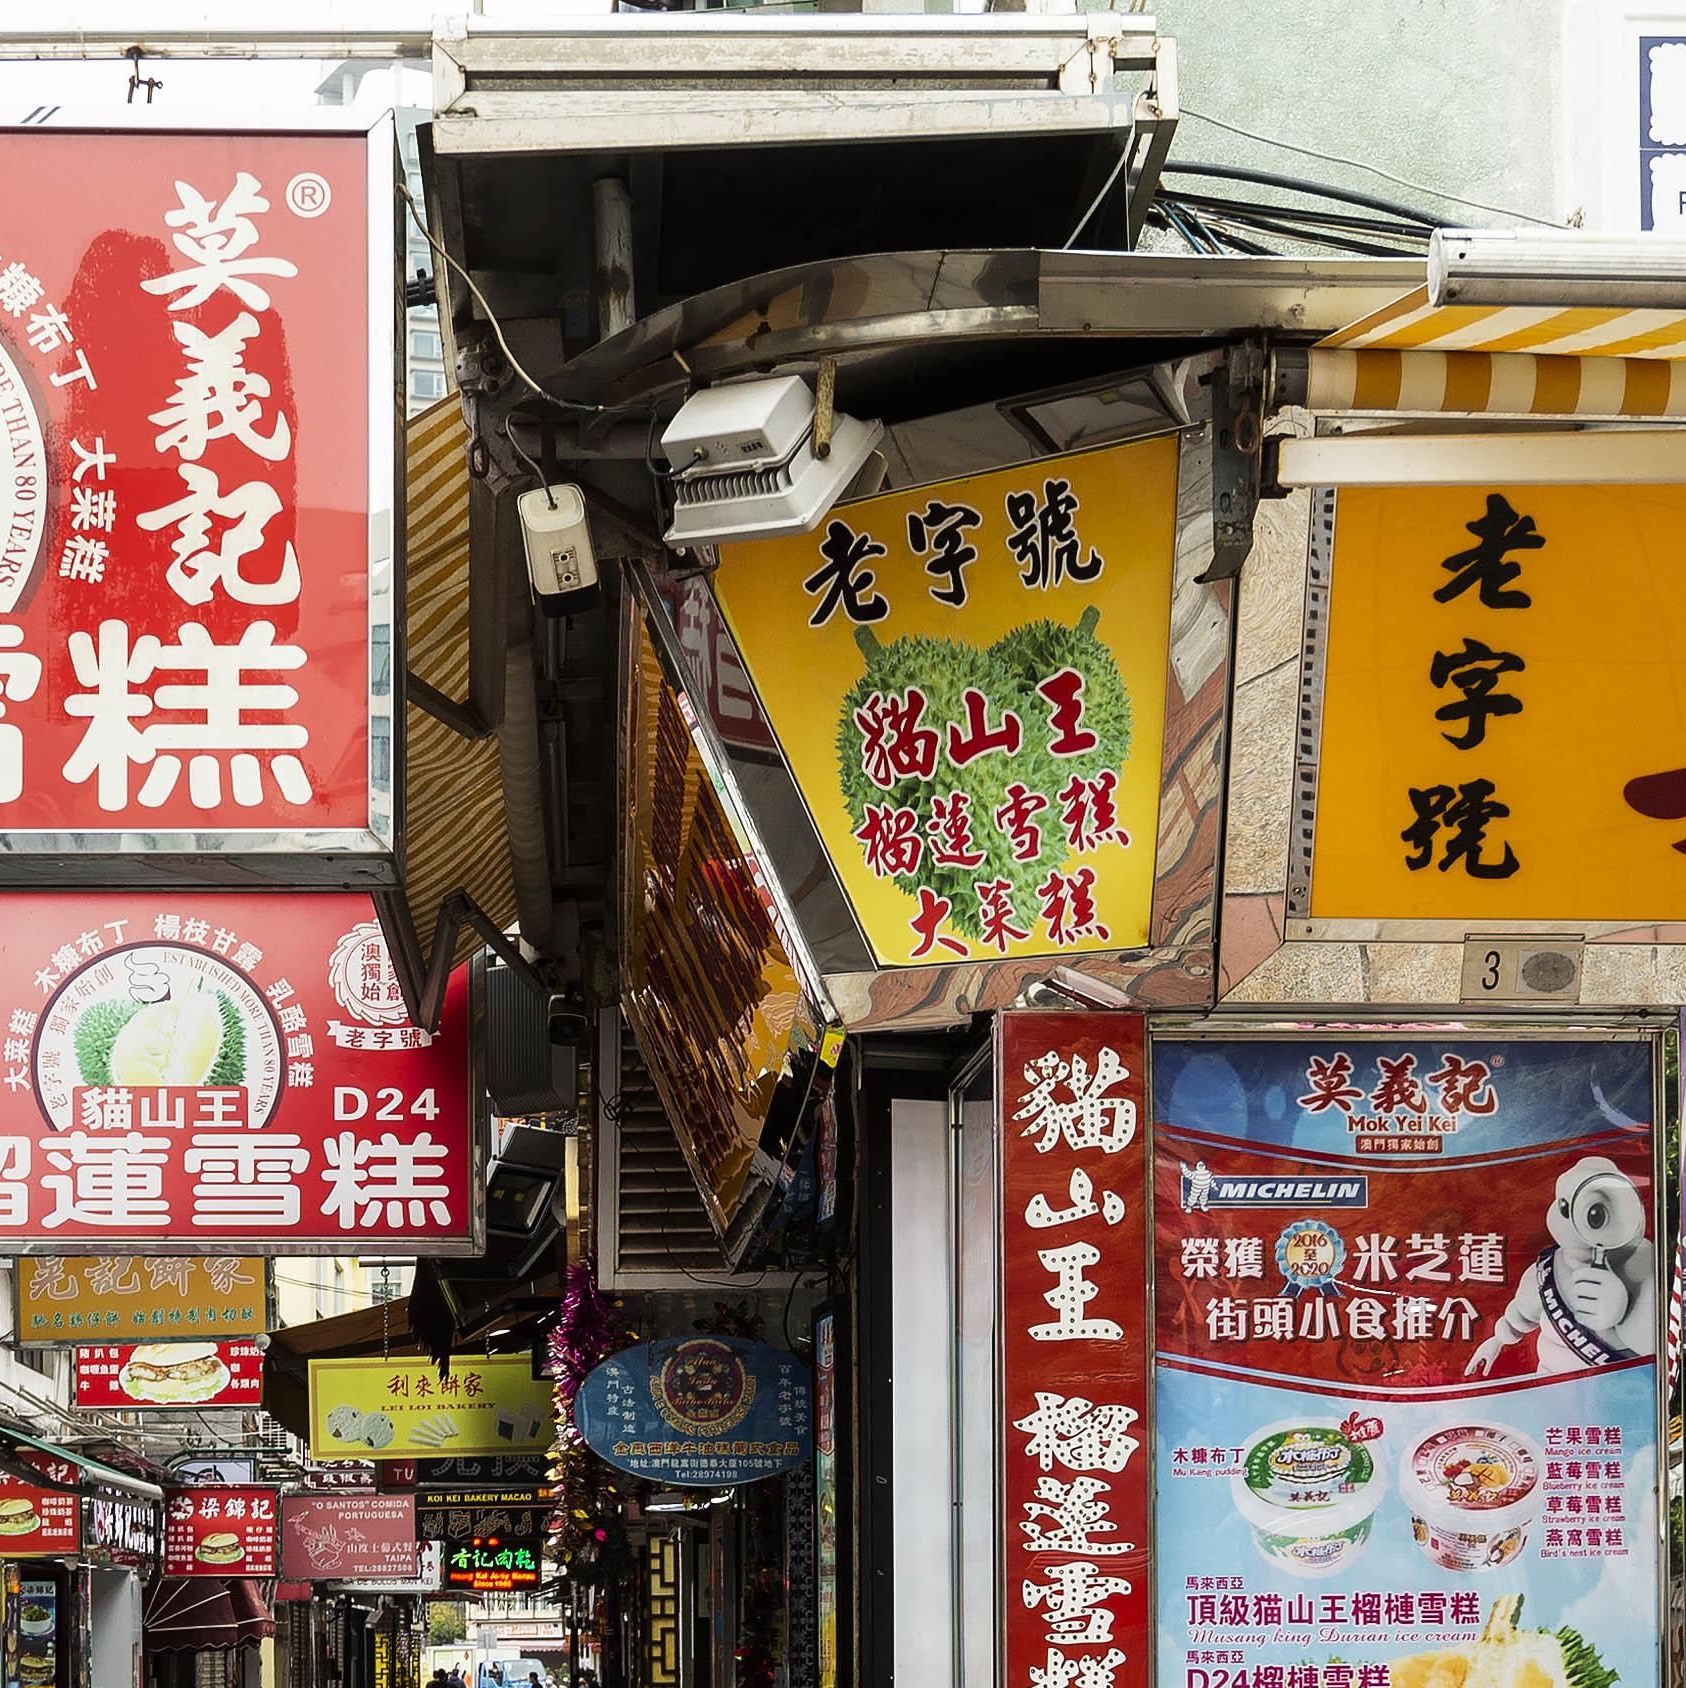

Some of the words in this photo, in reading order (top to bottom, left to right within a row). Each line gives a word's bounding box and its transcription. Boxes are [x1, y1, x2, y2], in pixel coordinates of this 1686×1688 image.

[141, 170, 303, 608] 莫義記
[1, 396, 36, 470] THAN
[14, 476, 37, 501] 80
[56, 437, 118, 584] 大菜糕
[804, 480, 1103, 627] 老字號
[1400, 493, 1547, 880] 老字號
[858, 772, 1131, 877] 榴蓮雪糕
[908, 868, 1113, 959] 大菜糕
[32, 918, 130, 995] 木糠布丁
[154, 913, 265, 973] 楊枝甘露
[162, 951, 240, 999] ESTABLISHED
[1481, 948, 1503, 991] 3
[49, 966, 114, 1036] 獨家始創
[239, 991, 267, 1027] MORE
[2, 1007, 39, 1092] 大菜糕
[258, 1024, 277, 1057] THAN
[265, 978, 315, 1089] 乳酪雪糕
[345, 1028, 423, 1049] 老字號
[41, 1048, 69, 1111] 老字號
[253, 1074, 276, 1116] YEARS
[1297, 1052, 1499, 1116] 莫義記
[80, 1089, 244, 1130] 貓山王
[333, 1087, 441, 1122] D24
[1348, 1116, 1389, 1133] Mok
[1396, 1116, 1422, 1133] Yei
[1429, 1116, 1457, 1133] Kei
[1012, 1046, 1137, 1341] 貓山王
[1219, 1182, 1360, 1199] MICHELIN
[1180, 1237, 1264, 1280] 榮獲
[1353, 1233, 1505, 1283] 米芝蓮
[1205, 1298, 1479, 1341] 街頭小食推介
[381, 1403, 404, 1411] LEI
[409, 1403, 432, 1411] LOI
[437, 1403, 495, 1411] BAKERY
[1173, 1447, 1246, 1465] 木糠布丁
[198, 1498, 274, 1521] 梁錦記
[338, 1511, 404, 1520] PORTUGUESA
[371, 1500, 409, 1509] COMIDA
[446, 1494, 461, 1502] KEI
[464, 1494, 499, 1502] BAKERY
[501, 1493, 531, 1501] MACAO
[385, 1554, 412, 1562] TAIPA
[451, 1548, 536, 1570] 香記肉乾
[1186, 1577, 1244, 1591] 馬來西亞
[1186, 1593, 1481, 1627] 頂級猫山王榴槤雪糕
[1186, 1650, 1244, 1664] 馬來西亞
[1272, 1628, 1313, 1647] king
